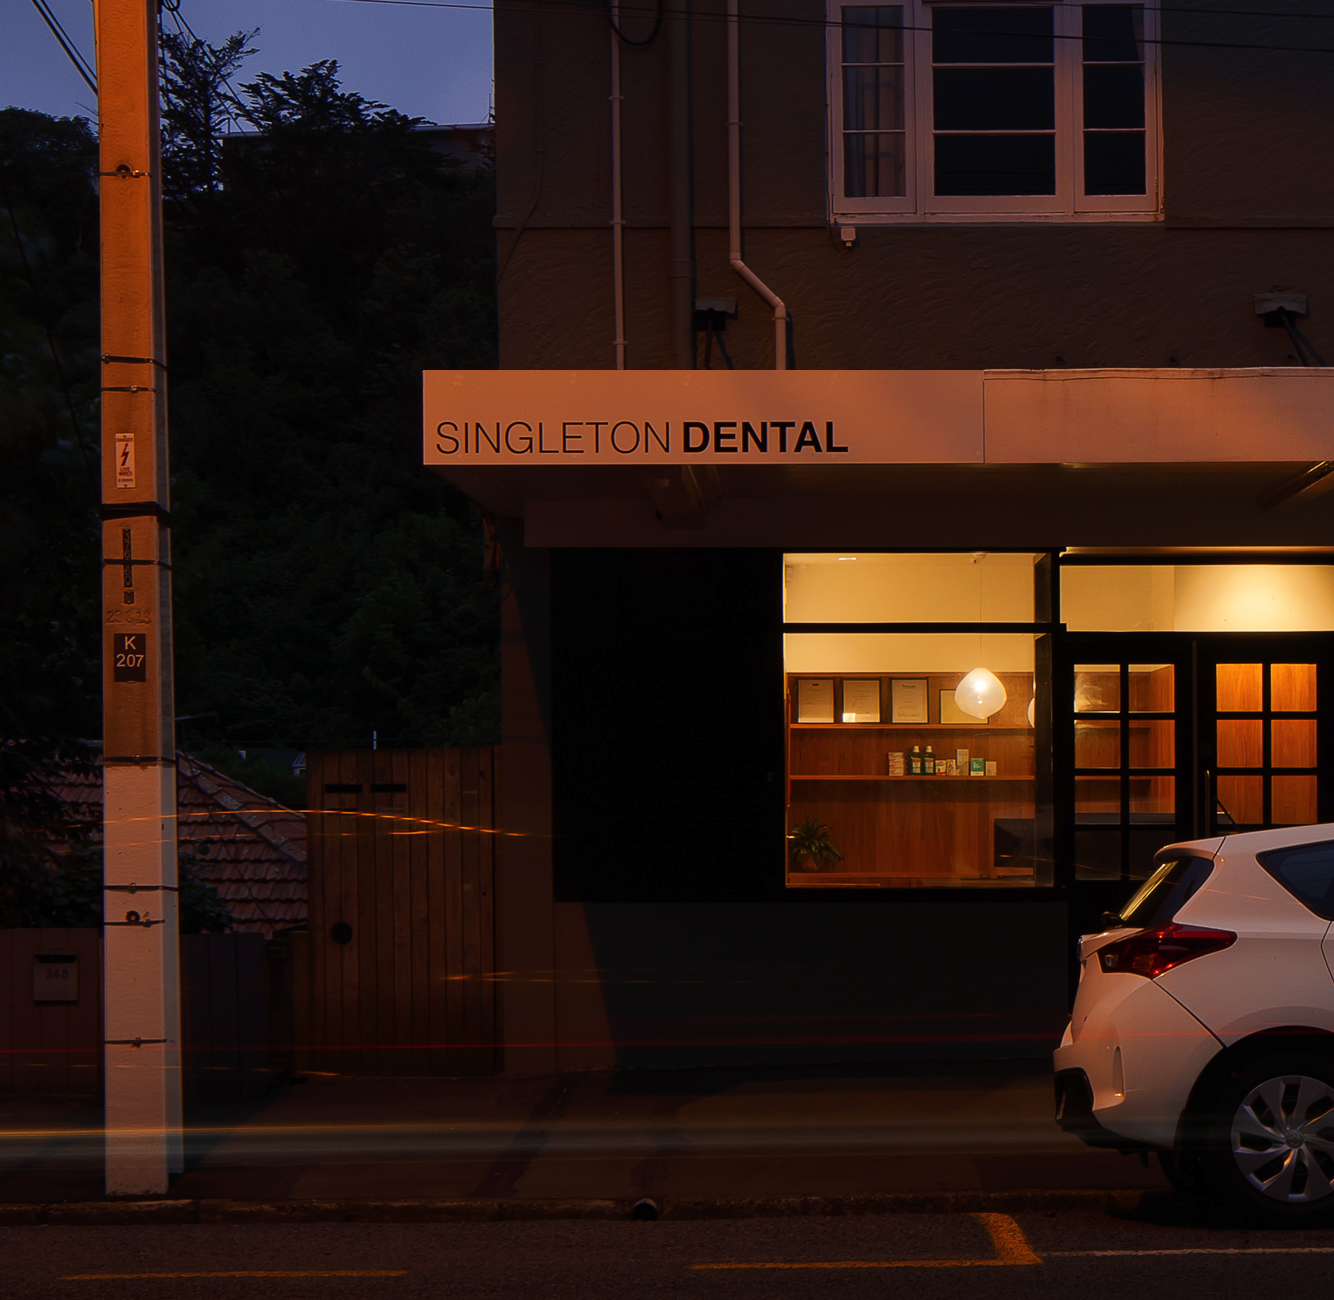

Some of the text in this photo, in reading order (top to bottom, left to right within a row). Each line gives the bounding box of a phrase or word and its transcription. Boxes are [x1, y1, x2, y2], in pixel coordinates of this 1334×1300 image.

[436, 420, 849, 455] SINGLETON DENTAL
[124, 636, 136, 650] K
[116, 654, 144, 667] 207
